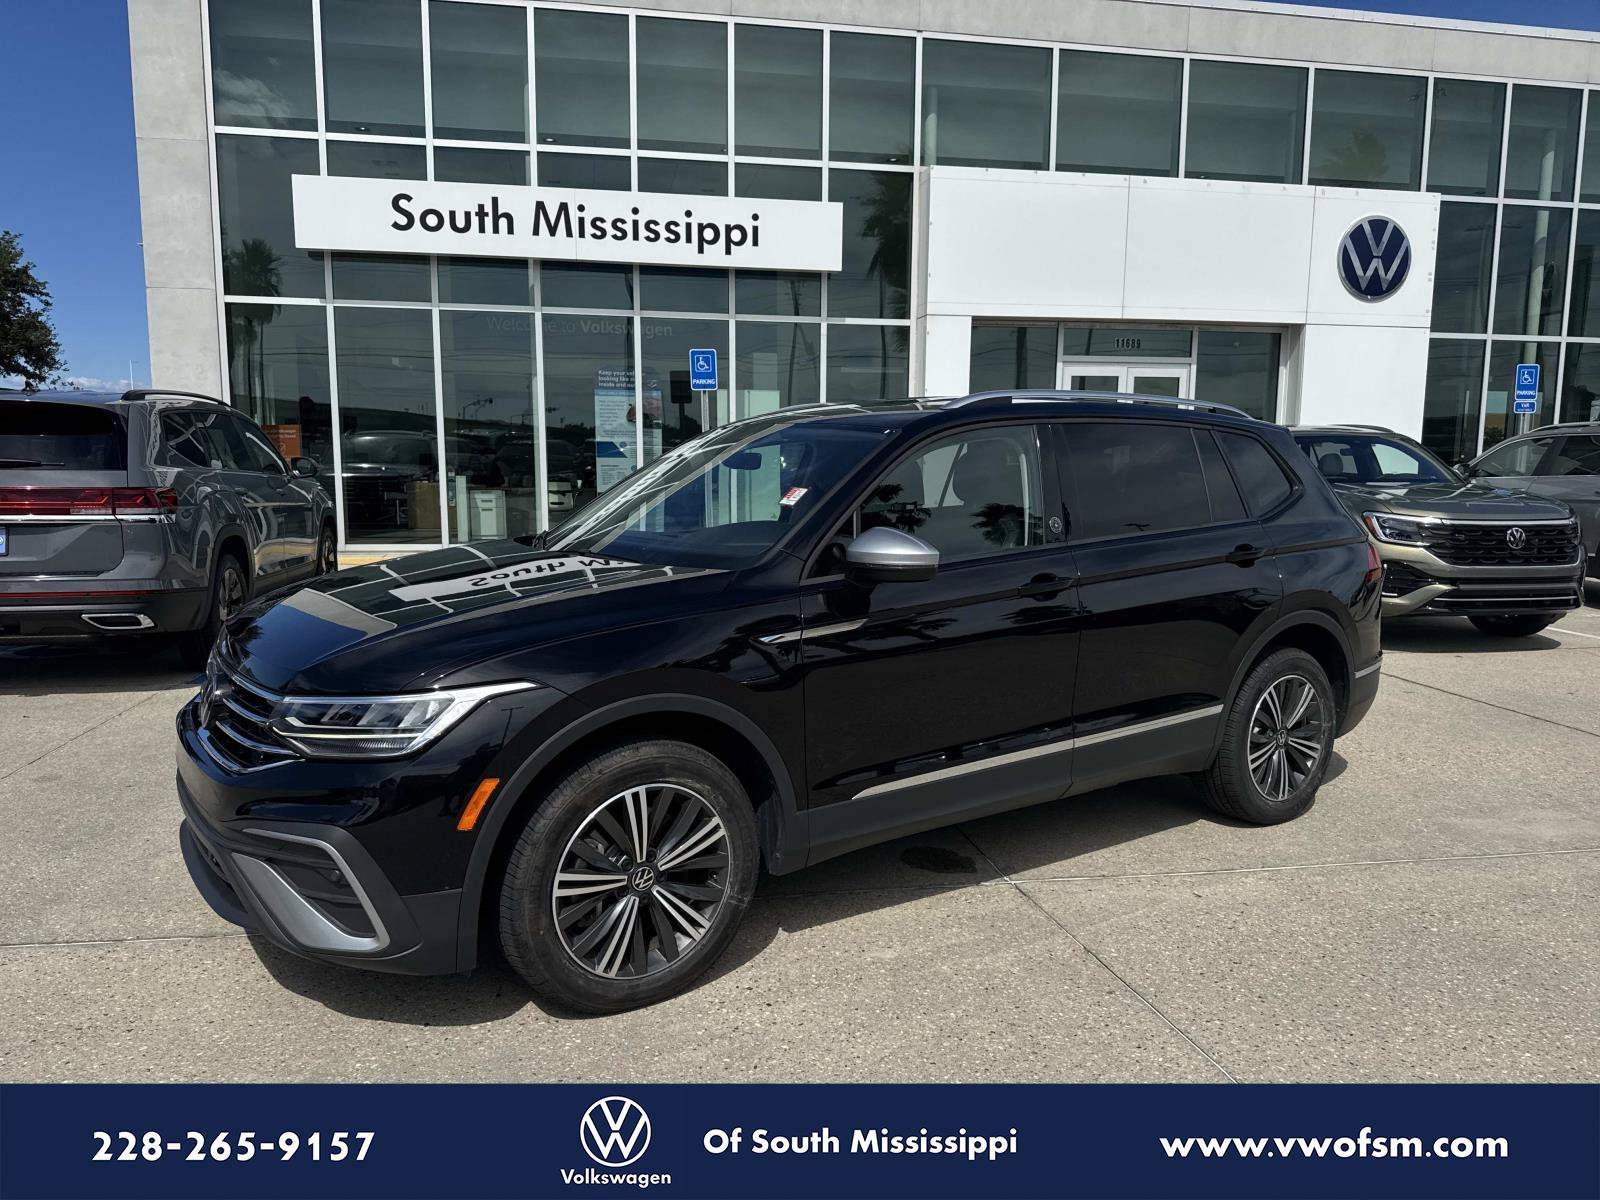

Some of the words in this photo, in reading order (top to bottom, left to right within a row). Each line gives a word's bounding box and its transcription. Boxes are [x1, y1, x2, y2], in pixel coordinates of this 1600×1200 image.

[391, 193, 515, 235] South
[532, 200, 760, 255] Mississippi
[486, 316, 557, 332] Welce
[1116, 338, 1141, 349] 11689
